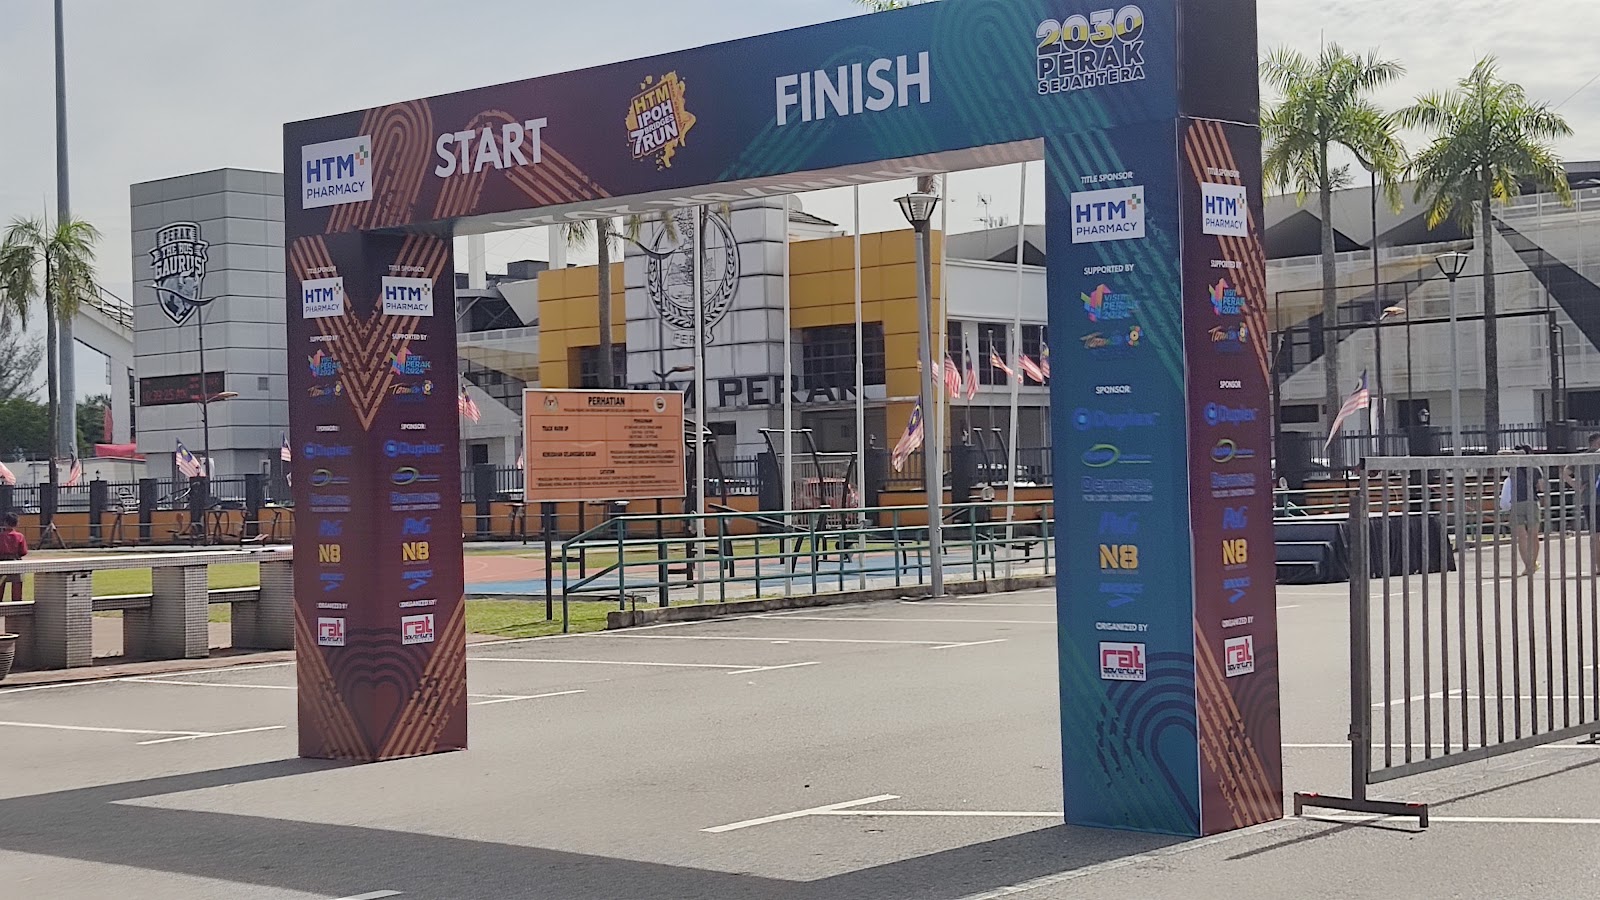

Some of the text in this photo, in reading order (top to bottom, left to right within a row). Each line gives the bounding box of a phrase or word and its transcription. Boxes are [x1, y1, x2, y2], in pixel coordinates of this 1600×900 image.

[1036, 4, 1144, 56] 2030
[1037, 40, 1144, 81] PERAK
[776, 51, 931, 126] FINISH
[1037, 65, 1146, 95] SEJAHTERA
[633, 84, 670, 115] HTM
[637, 99, 673, 129] IPOH
[643, 113, 675, 135] BRIDGES
[642, 121, 679, 152] RUN
[435, 117, 547, 178] START
[306, 152, 356, 184] HTM
[1081, 171, 1133, 184] TITLE SPONSOR
[306, 181, 366, 199] PHARMACY
[1076, 200, 1126, 223] HTM
[1206, 195, 1237, 217] HTM
[1076, 222, 1137, 236] PHARMACY
[1206, 218, 1243, 229] PHARMACY
[161, 243, 177, 258] THE
[1083, 263, 1134, 275] SUPPORTED BY
[305, 288, 333, 303] HTM
[386, 286, 421, 301] HTM
[305, 303, 340, 313] PHARMACY
[386, 303, 428, 311] PHARMACY
[405, 360, 431, 368] PERAK
[588, 396, 625, 406] PERHATIAN
[318, 544, 341, 563] N8
[402, 541, 430, 561] N8
[1100, 544, 1139, 569] N8
[1223, 538, 1248, 565] N8
[319, 620, 343, 637] rat
[403, 616, 433, 636] rat
[1096, 622, 1148, 632] ORGANIZED BY
[1102, 645, 1144, 668] rat
[1226, 639, 1252, 665] rat
